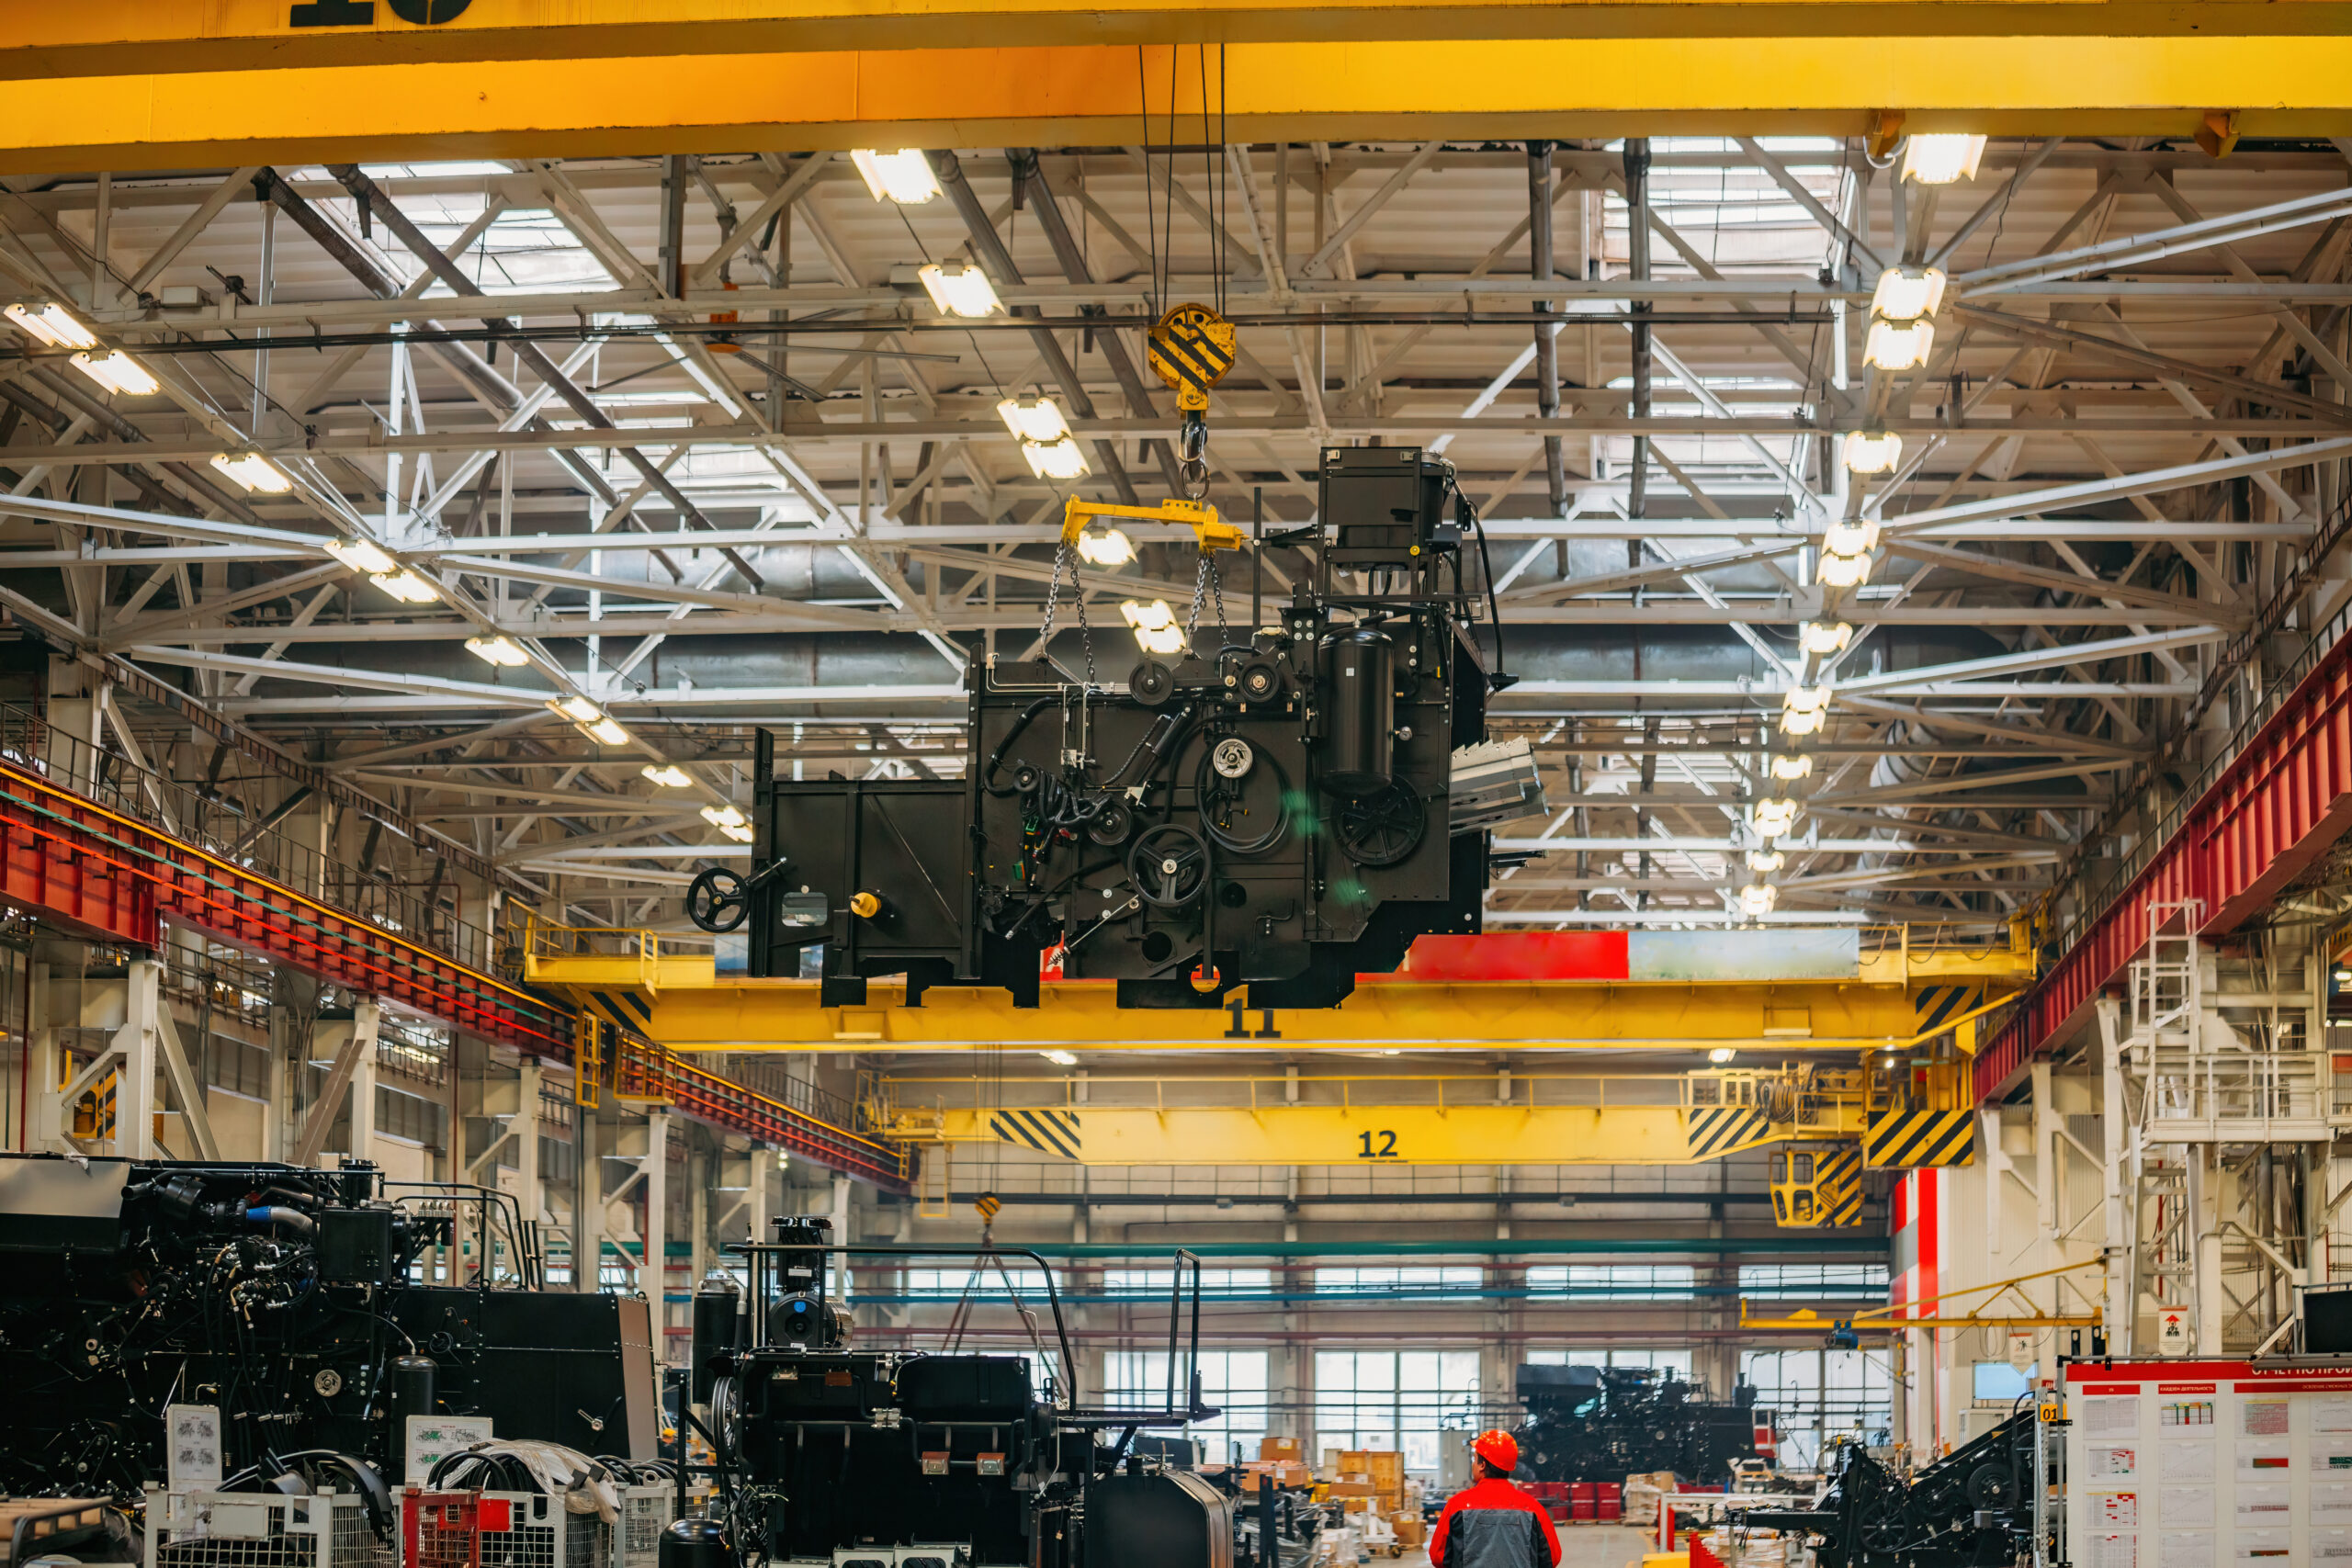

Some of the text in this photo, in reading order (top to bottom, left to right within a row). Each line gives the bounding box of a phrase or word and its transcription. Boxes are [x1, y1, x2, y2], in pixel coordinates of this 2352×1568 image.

[1224, 998, 1281, 1038] 11
[1358, 1130, 1397, 1157] 12
[2042, 1408, 2058, 1420] 01
